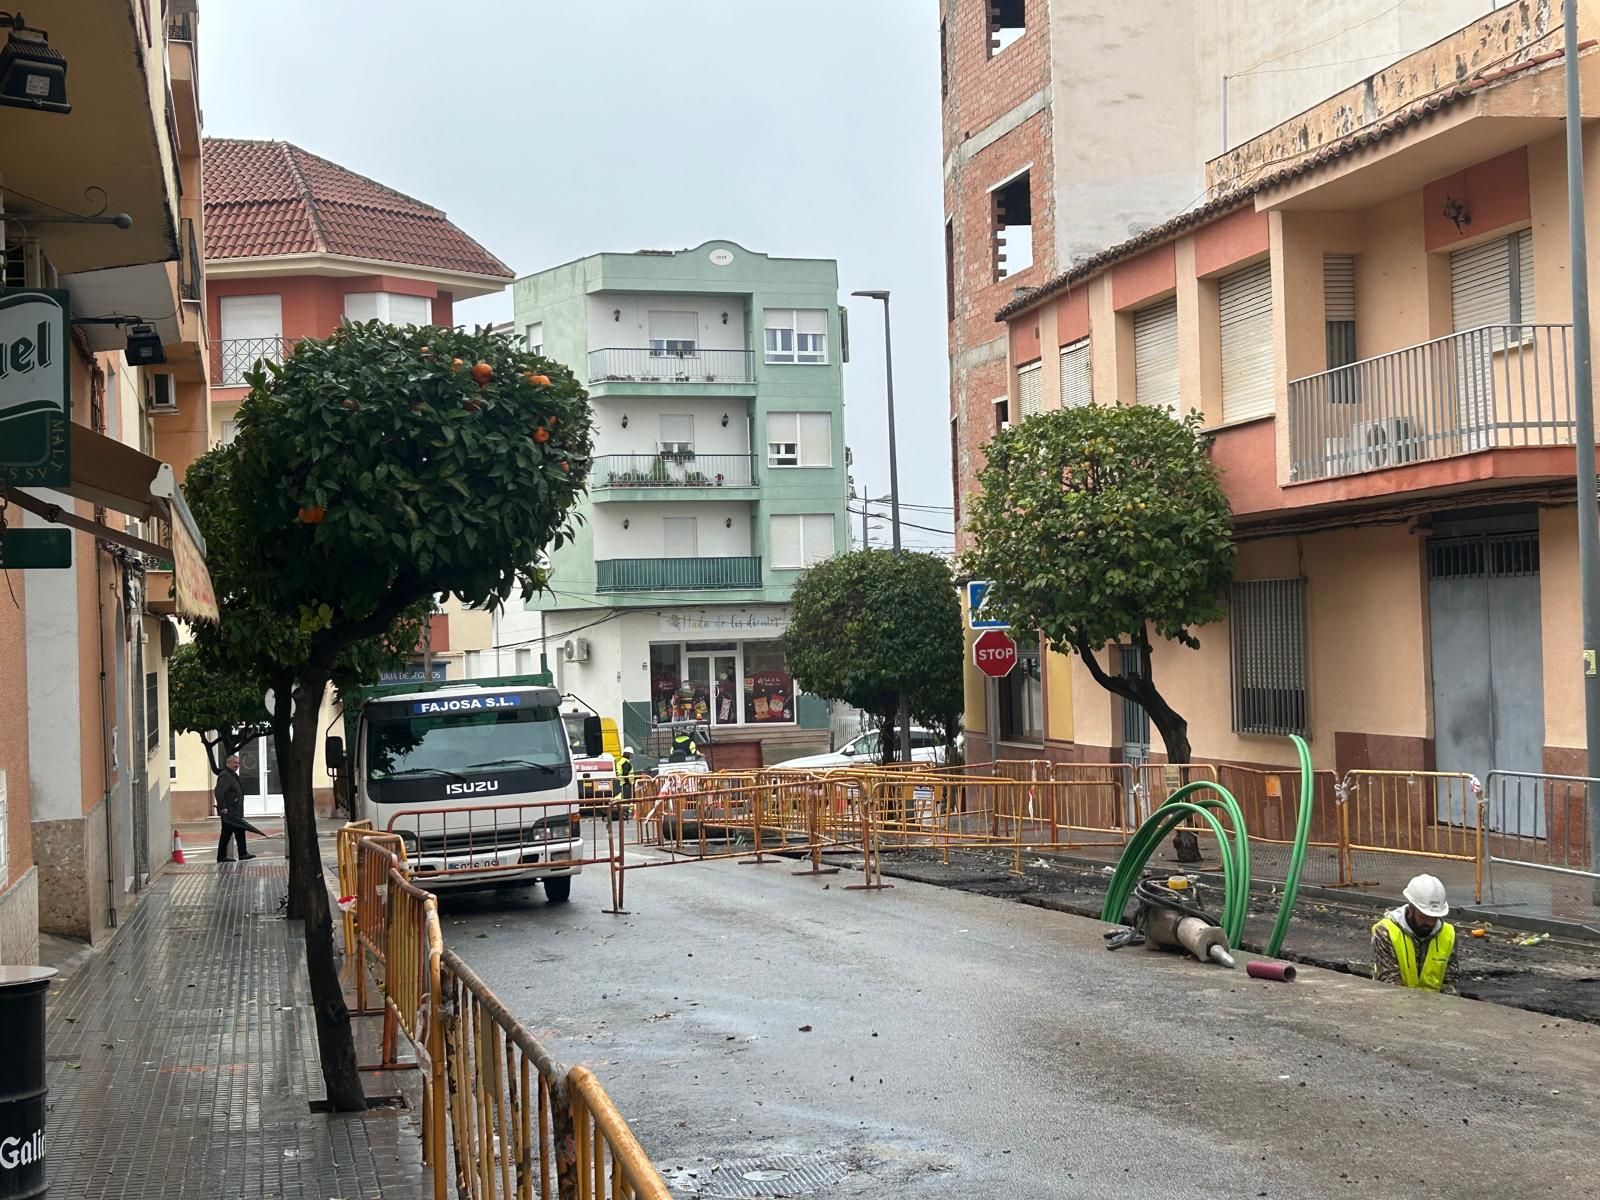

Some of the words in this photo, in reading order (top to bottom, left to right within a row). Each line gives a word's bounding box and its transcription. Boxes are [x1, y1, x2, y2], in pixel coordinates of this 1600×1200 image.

[978, 647, 1014, 660] STOP
[421, 698, 482, 713] FAJOSA
[485, 697, 514, 708] S.L.
[446, 780, 499, 795] ISUZU
